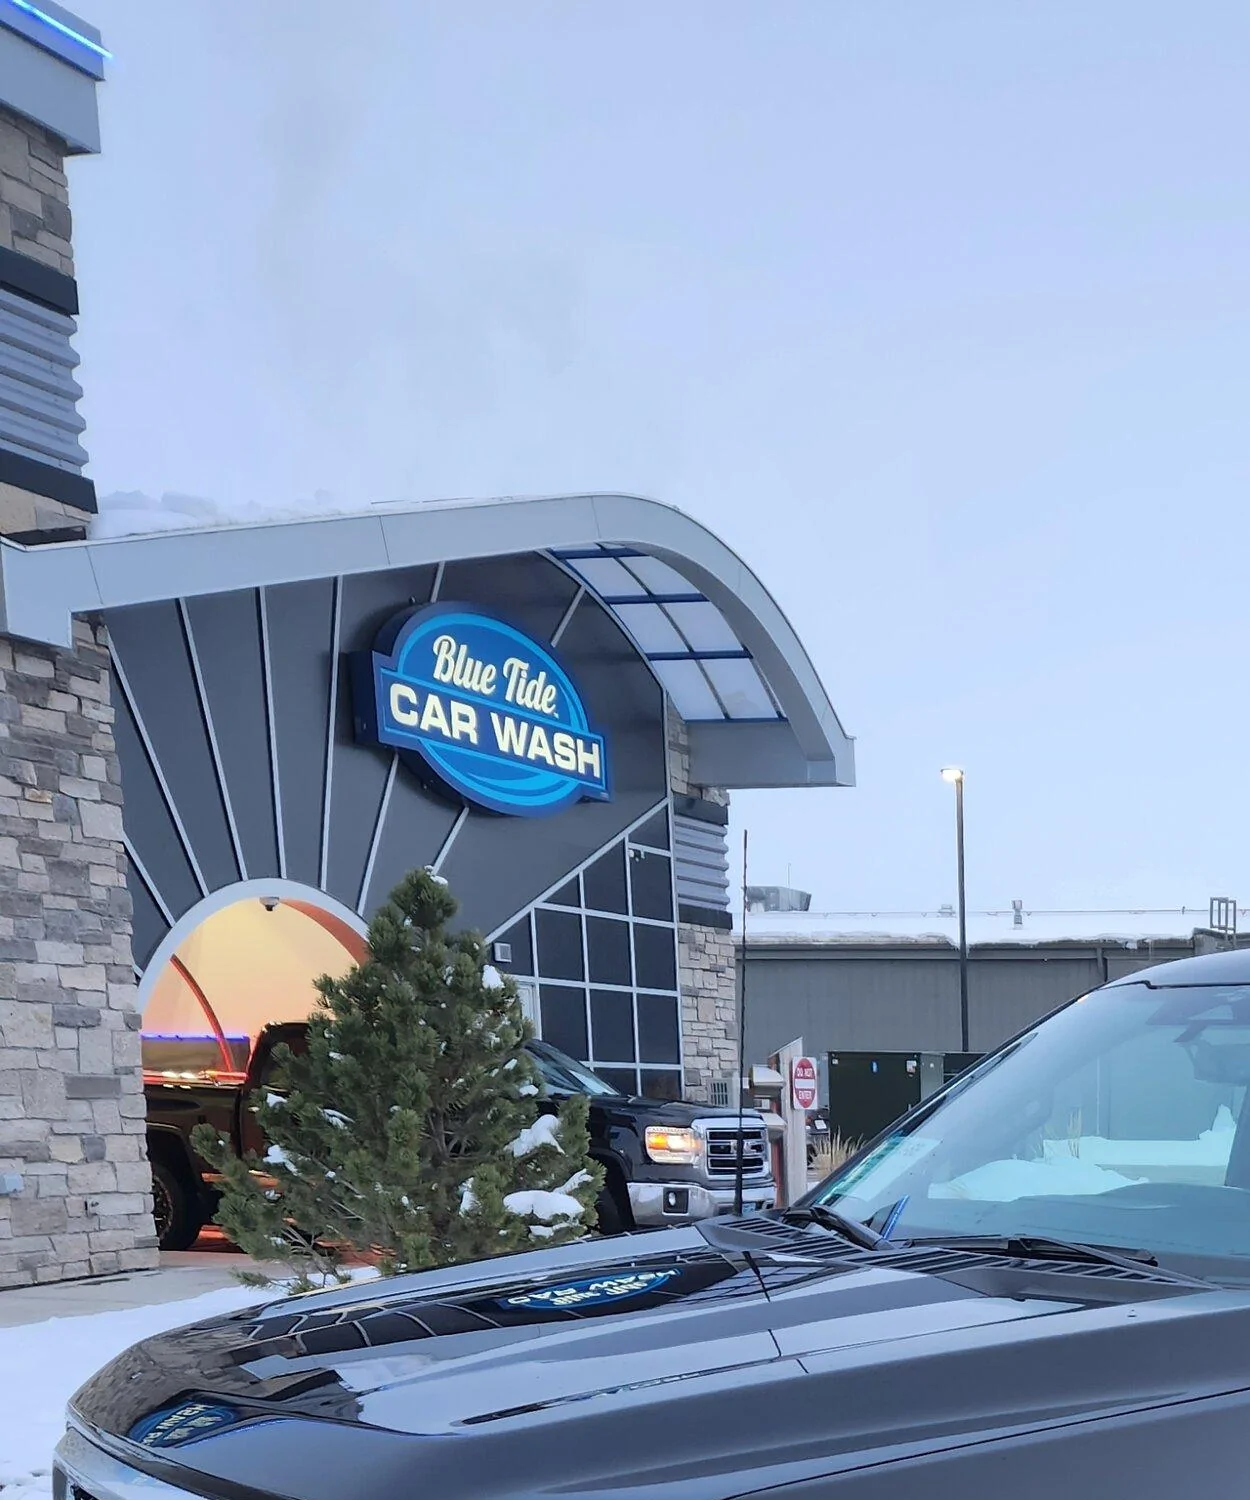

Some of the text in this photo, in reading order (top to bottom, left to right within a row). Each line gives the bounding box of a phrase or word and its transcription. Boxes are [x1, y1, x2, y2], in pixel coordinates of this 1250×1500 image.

[432, 634, 557, 714] Blue Tide
[390, 683, 601, 778] CAR WASH
[797, 1067, 804, 1077] DO
